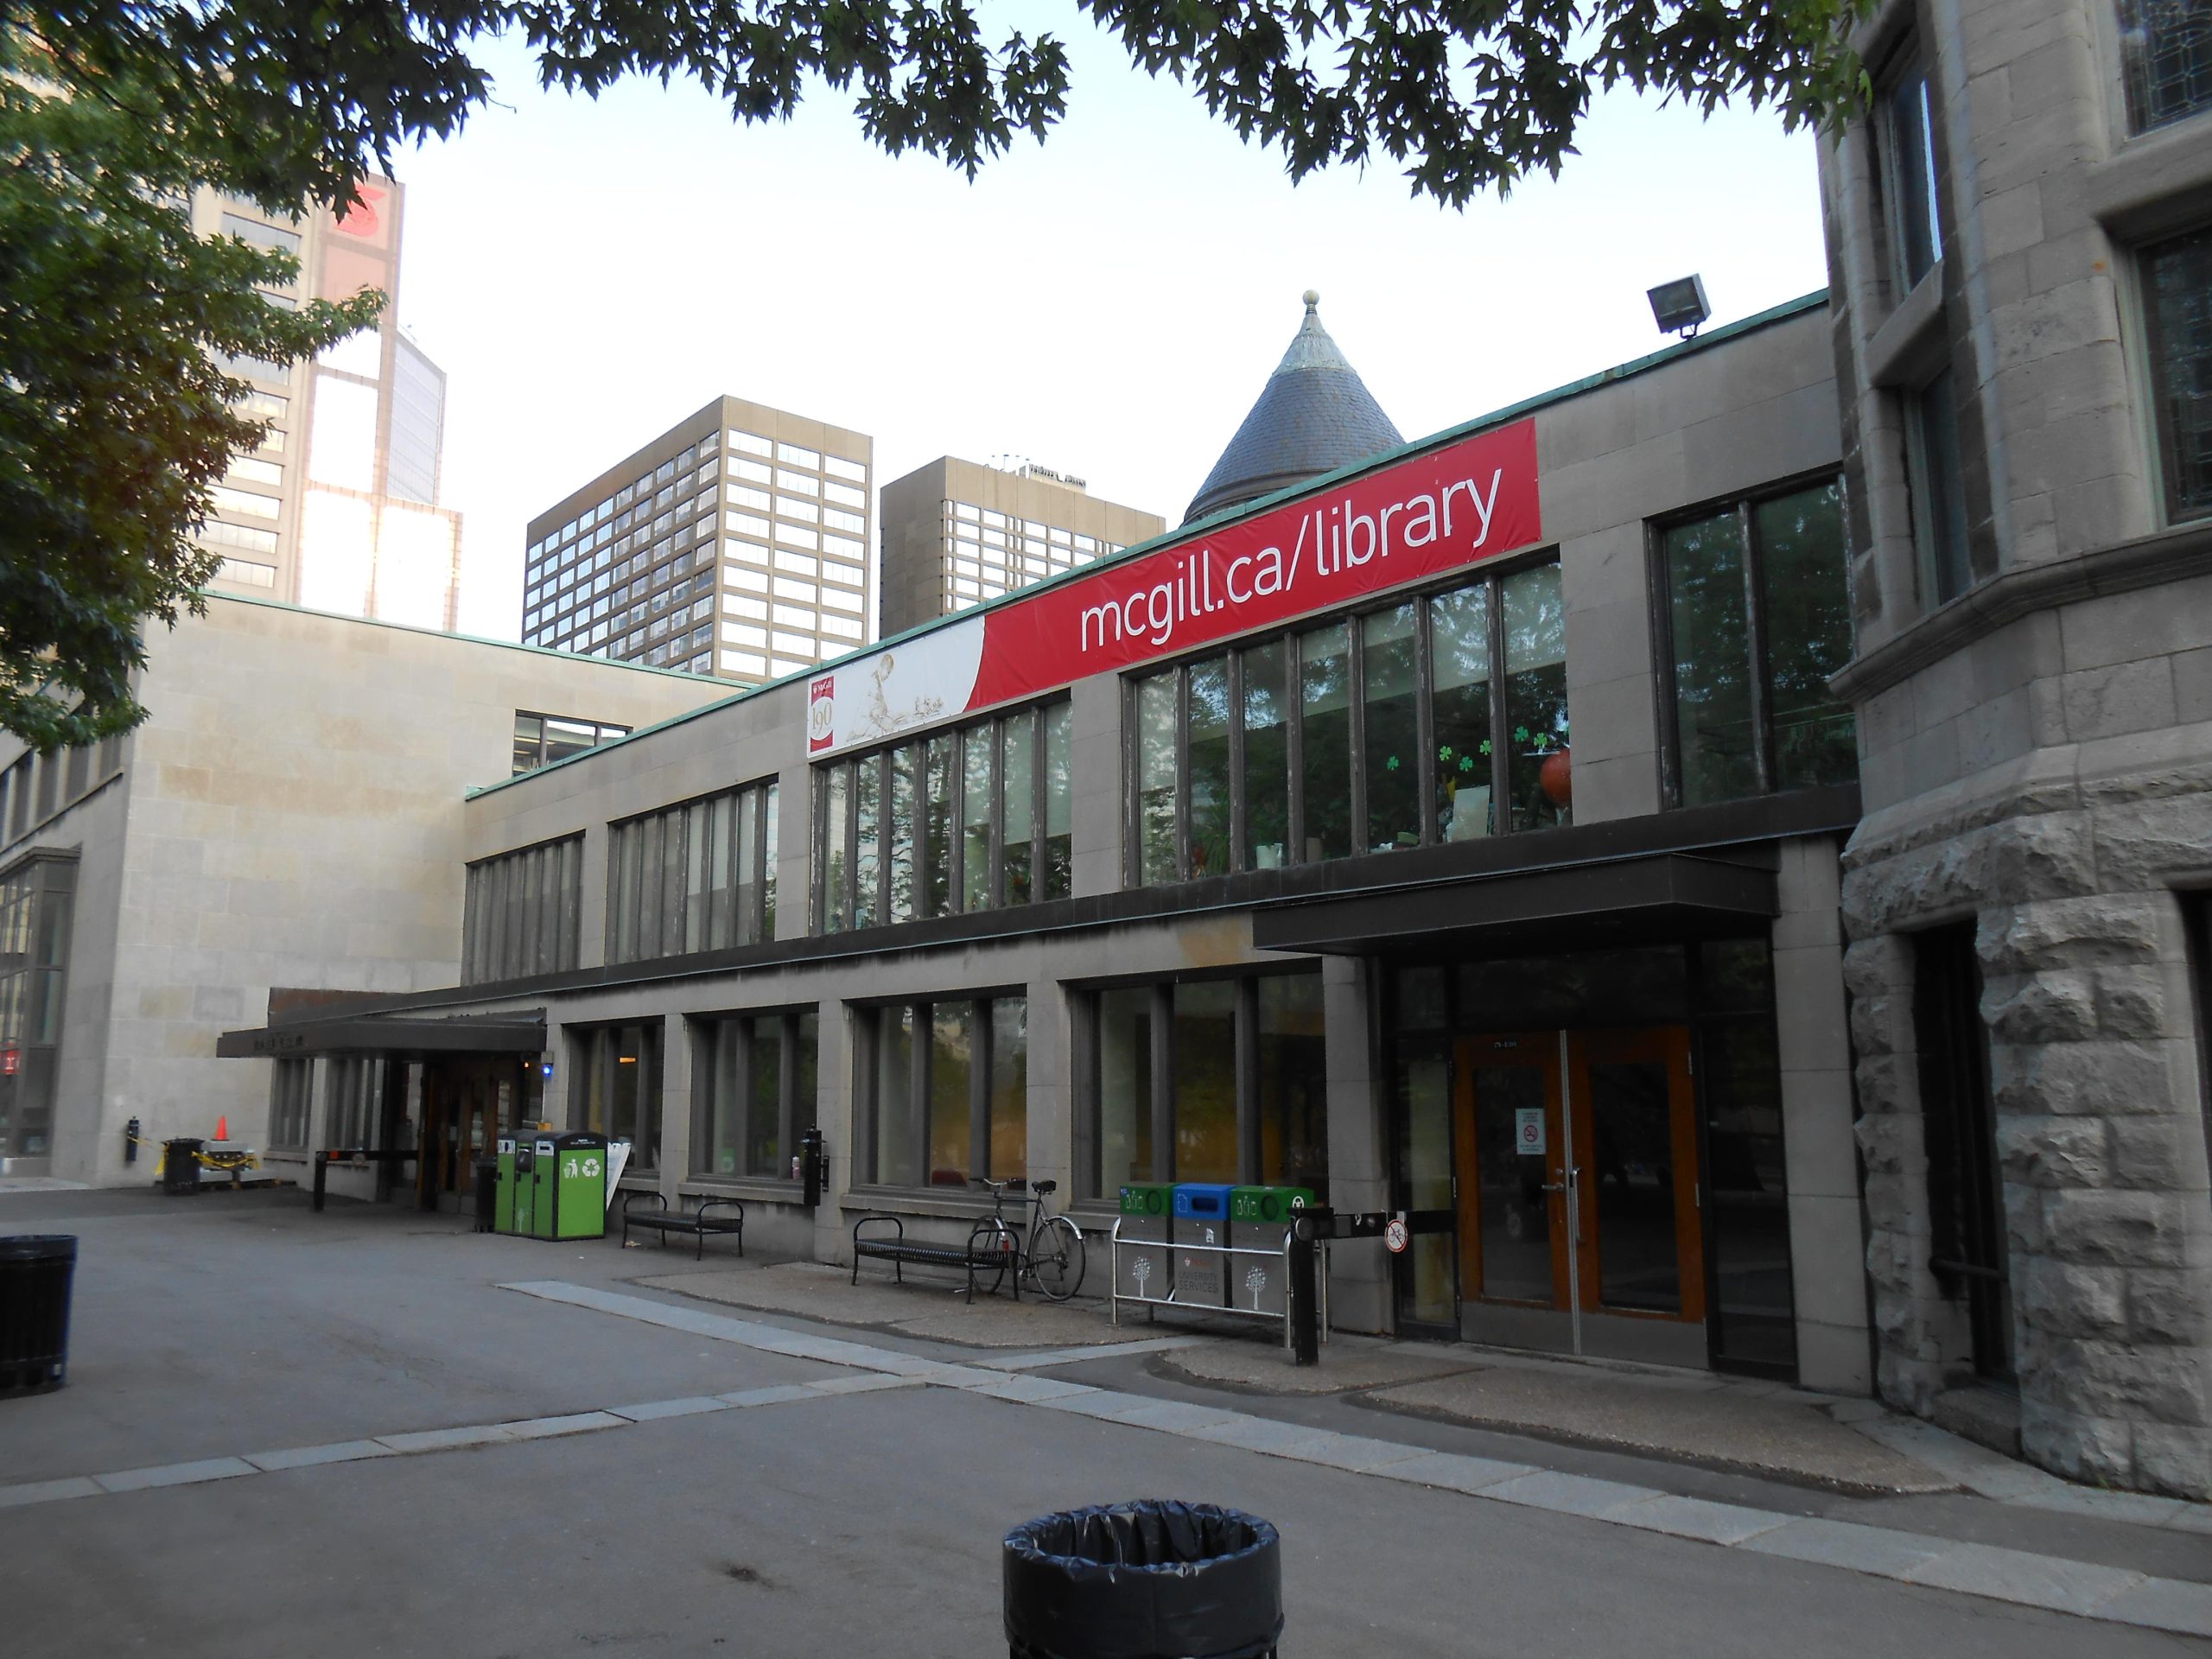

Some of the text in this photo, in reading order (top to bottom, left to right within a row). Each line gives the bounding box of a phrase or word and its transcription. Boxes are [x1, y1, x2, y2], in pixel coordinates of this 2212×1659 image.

[1082, 468, 1502, 652] mcgill.ca/library
[813, 702, 832, 735] 190
[1179, 1281, 1219, 1294] SERVICES
